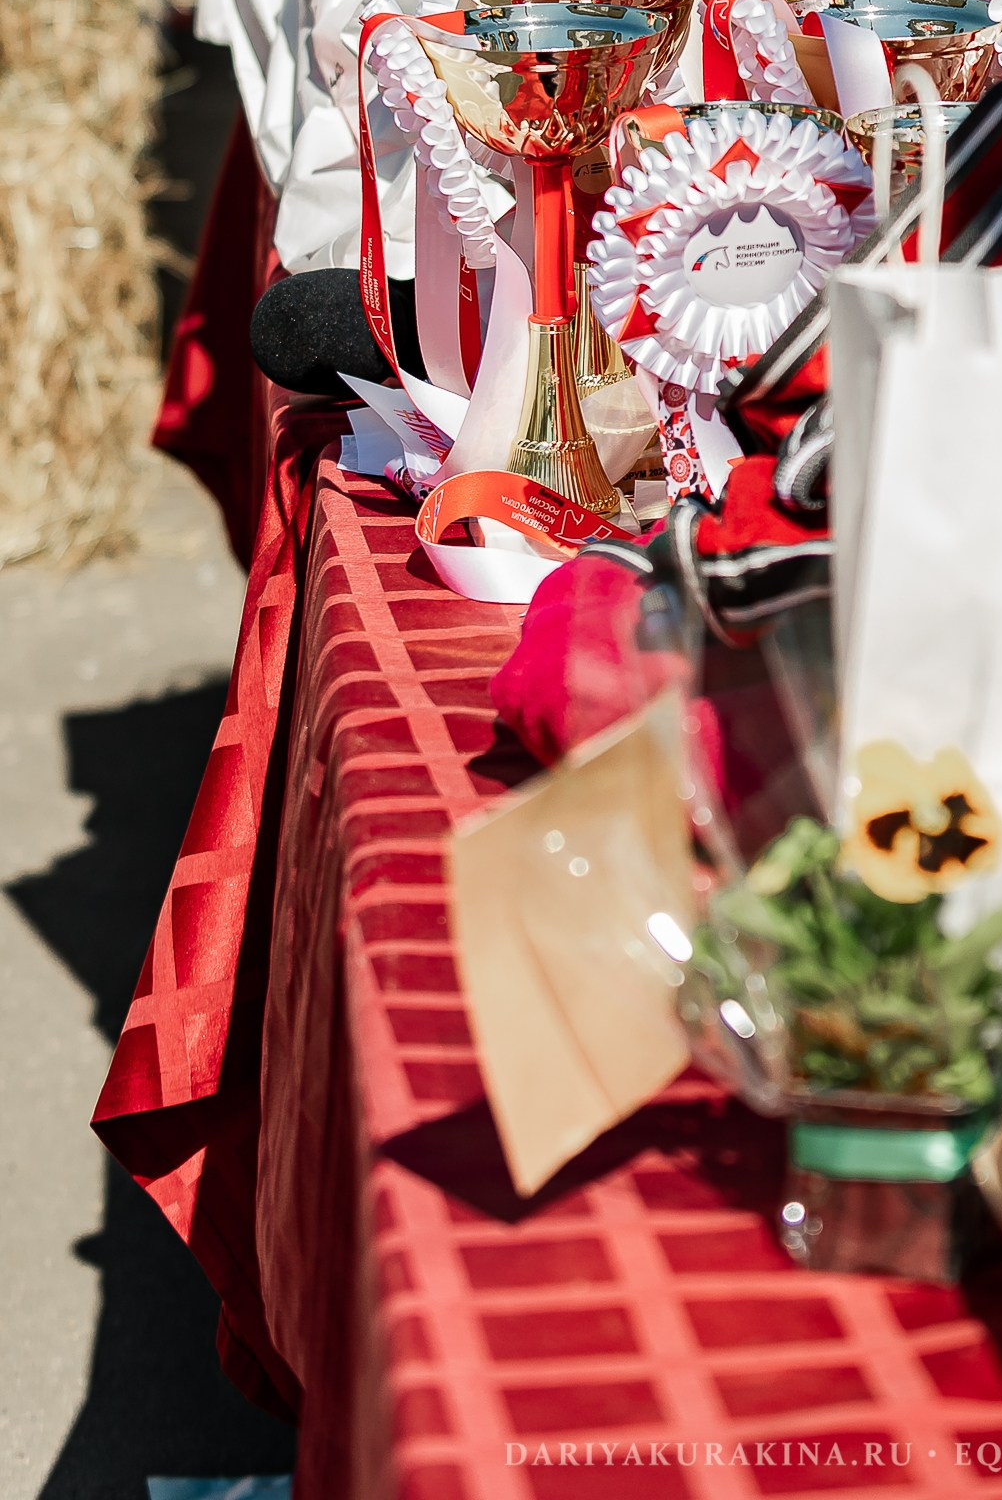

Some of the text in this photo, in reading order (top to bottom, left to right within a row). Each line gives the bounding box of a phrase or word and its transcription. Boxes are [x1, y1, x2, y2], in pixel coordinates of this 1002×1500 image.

[736, 247, 800, 259] КОННОГО СПОРТА
[736, 259, 766, 267] РОССИИ
[362, 256, 370, 306] ФЕДЕРАЦИЯ
[367, 269, 376, 309] КОННОГО
[373, 278, 381, 312] РОССИИ
[520, 504, 556, 525] КОННОГО
[528, 495, 561, 516] РОССИИ
